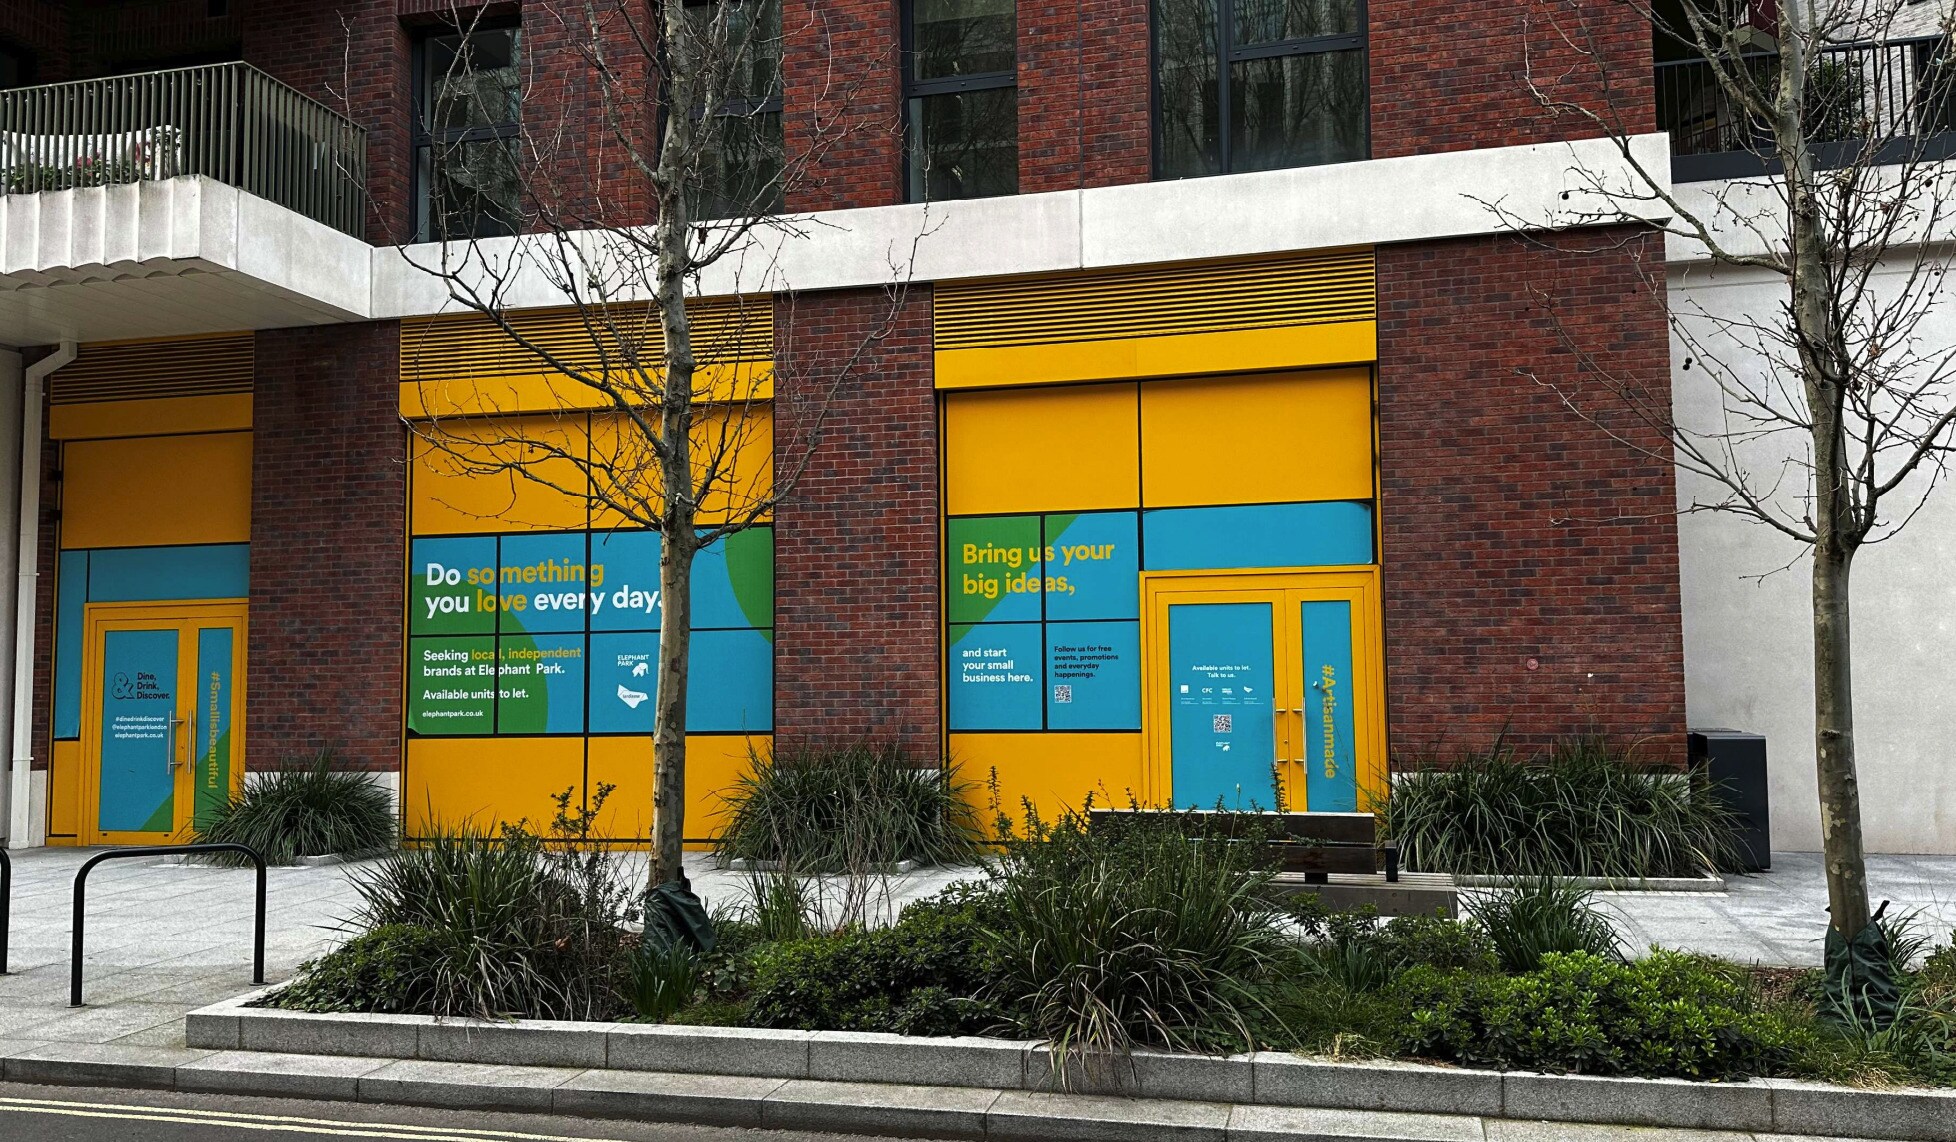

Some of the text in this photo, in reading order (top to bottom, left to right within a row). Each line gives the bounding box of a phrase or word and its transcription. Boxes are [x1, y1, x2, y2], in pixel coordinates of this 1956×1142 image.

[963, 542, 1115, 568] Bring us your
[426, 557, 604, 587] Do something
[963, 572, 1075, 599] big ideas,
[425, 595, 469, 619] you
[477, 589, 527, 612] love
[534, 591, 606, 615] every
[962, 648, 1007, 658] and start
[1098, 644, 1112, 652] free
[423, 647, 582, 664] Seeking local, independent
[1054, 654, 1119, 662] events, promotions
[423, 662, 565, 677] brands at Elephant Park.
[962, 660, 1014, 672] your small
[1068, 662, 1100, 670] everyday
[137, 672, 156, 680] Dine,
[962, 672, 1034, 683] business here.
[1054, 671, 1096, 680] happenings.
[137, 682, 160, 690] Drink,
[136, 691, 170, 700] Discover.
[423, 688, 529, 700] Available units to let.
[422, 709, 484, 718] elephantpark.co.uk
[1322, 664, 1339, 779] #Artisanmade
[208, 671, 221, 788] #Smallisbeautiful
